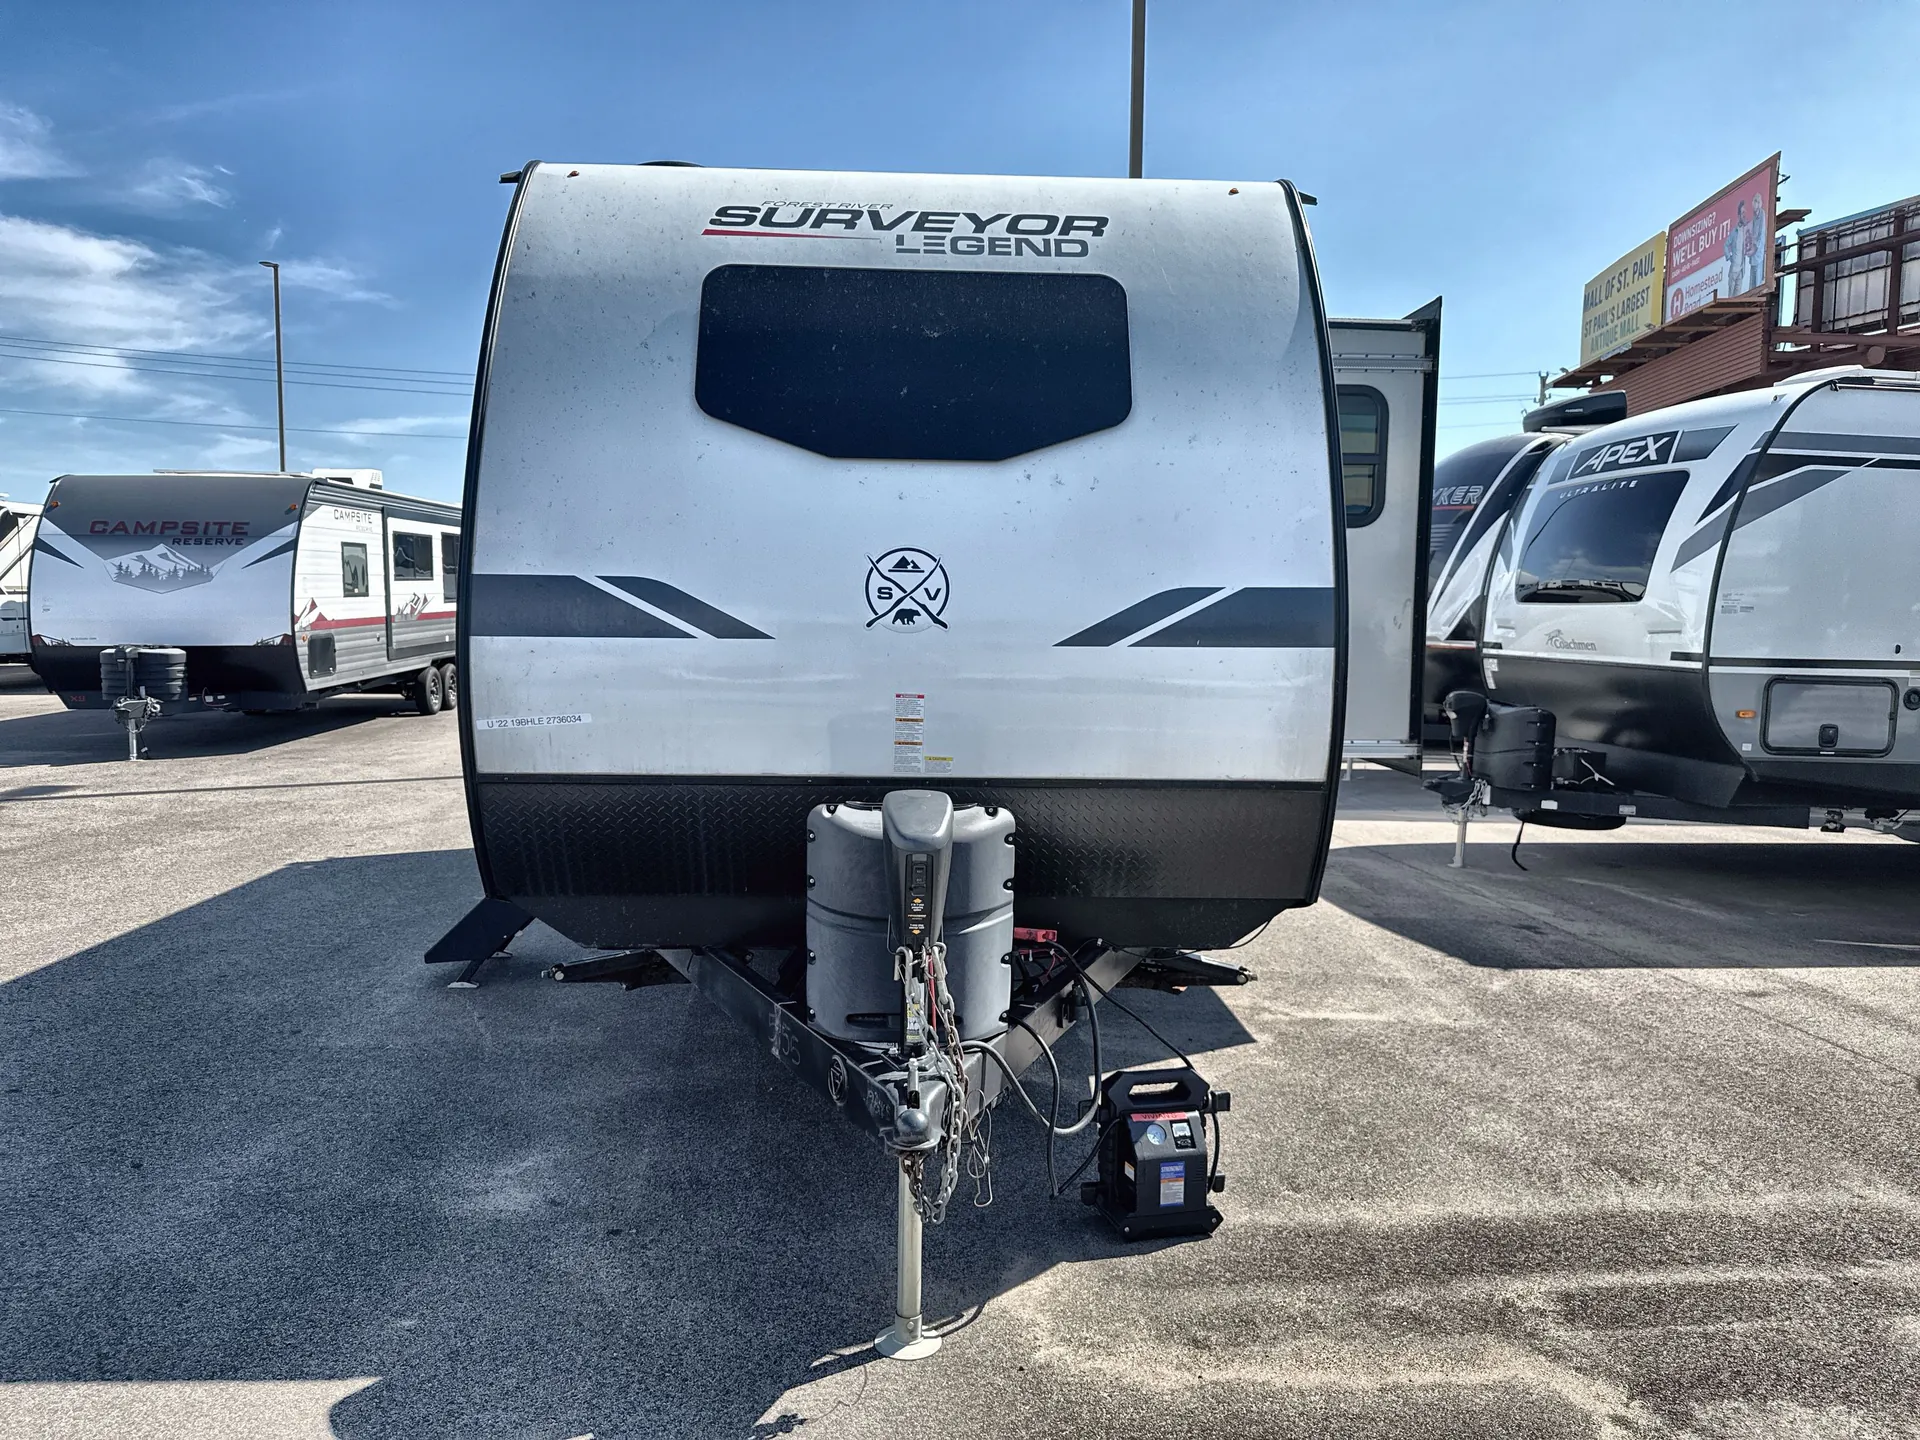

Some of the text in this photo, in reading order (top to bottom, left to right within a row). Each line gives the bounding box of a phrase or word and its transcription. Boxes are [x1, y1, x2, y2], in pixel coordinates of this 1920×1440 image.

[761, 200, 894, 210] FOREST RIVER
[708, 205, 1110, 237] SURVEYOR
[1673, 211, 1716, 249] DOWNSIZING?
[895, 234, 1090, 258] LEGEND
[1672, 240, 1697, 268] WE'LL
[1699, 226, 1718, 253] BUY
[1719, 218, 1731, 241] IT!
[1584, 284, 1603, 313] MALL
[1604, 275, 1616, 301] OF
[1616, 267, 1630, 294] ST.
[1631, 250, 1656, 284] PAUL
[1685, 266, 1724, 299] Homestead
[1593, 304, 1616, 334] PAUL'S
[1616, 285, 1651, 320] LARGEST
[1590, 323, 1619, 354] ANTIQUE
[1619, 313, 1640, 337] MALL
[1574, 436, 1672, 475] APEX
[1559, 480, 1639, 499] ULTRALITE
[89, 520, 251, 536] CAMPSITE
[333, 508, 373, 524] CAMPSITE
[172, 537, 245, 546] RESERVE
[876, 586, 942, 601] S V
[1553, 638, 1597, 651] Coachmen
[486, 720, 494, 728] U
[511, 717, 545, 727] 19BHLE
[546, 715, 582, 725] 2736034
